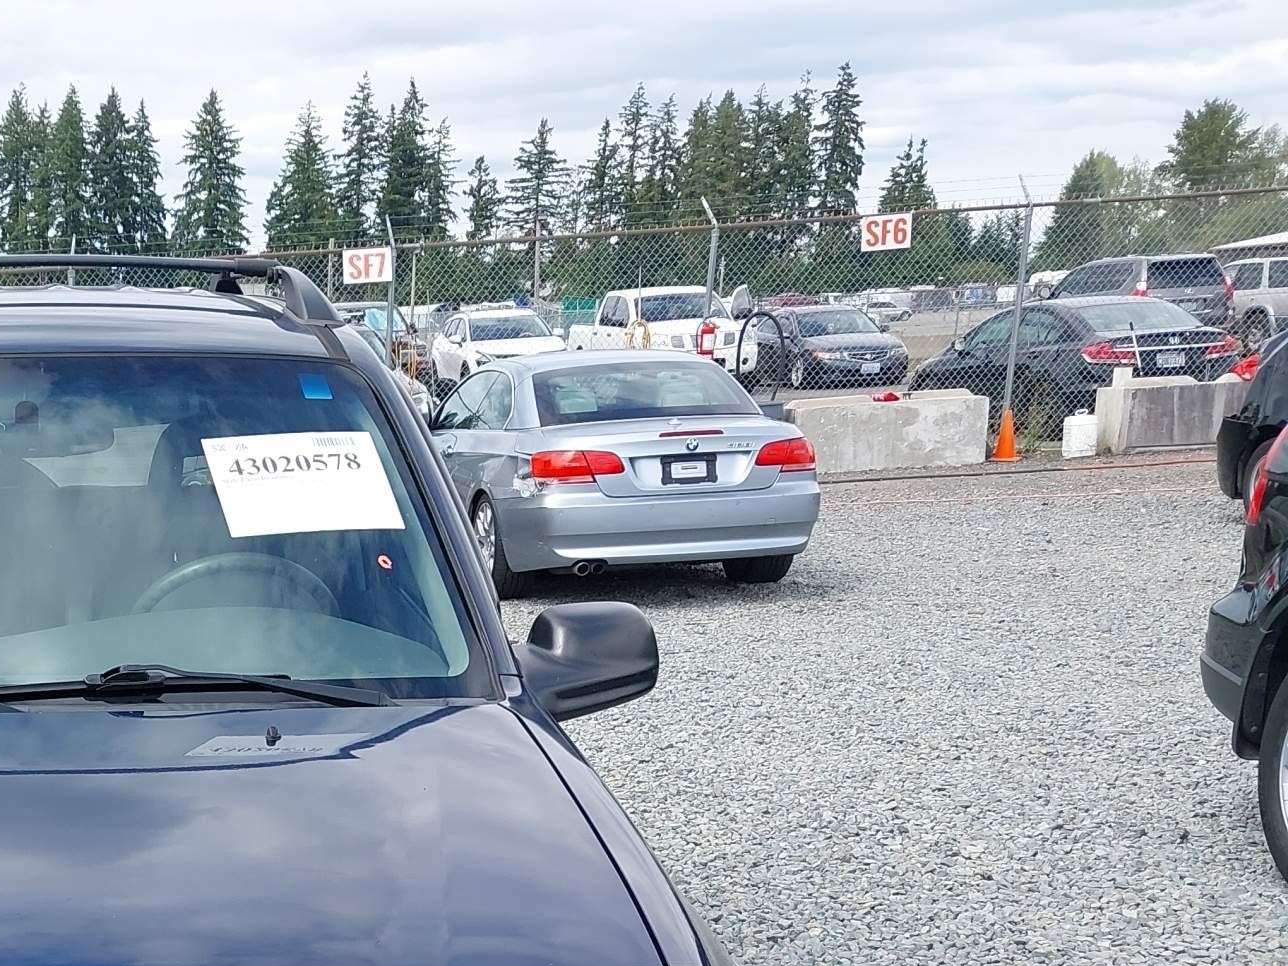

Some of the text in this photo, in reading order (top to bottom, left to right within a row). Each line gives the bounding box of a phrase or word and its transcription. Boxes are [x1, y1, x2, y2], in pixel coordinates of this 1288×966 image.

[865, 217, 908, 247] SF6
[348, 252, 386, 280] SF7
[228, 451, 362, 476] 43020578
